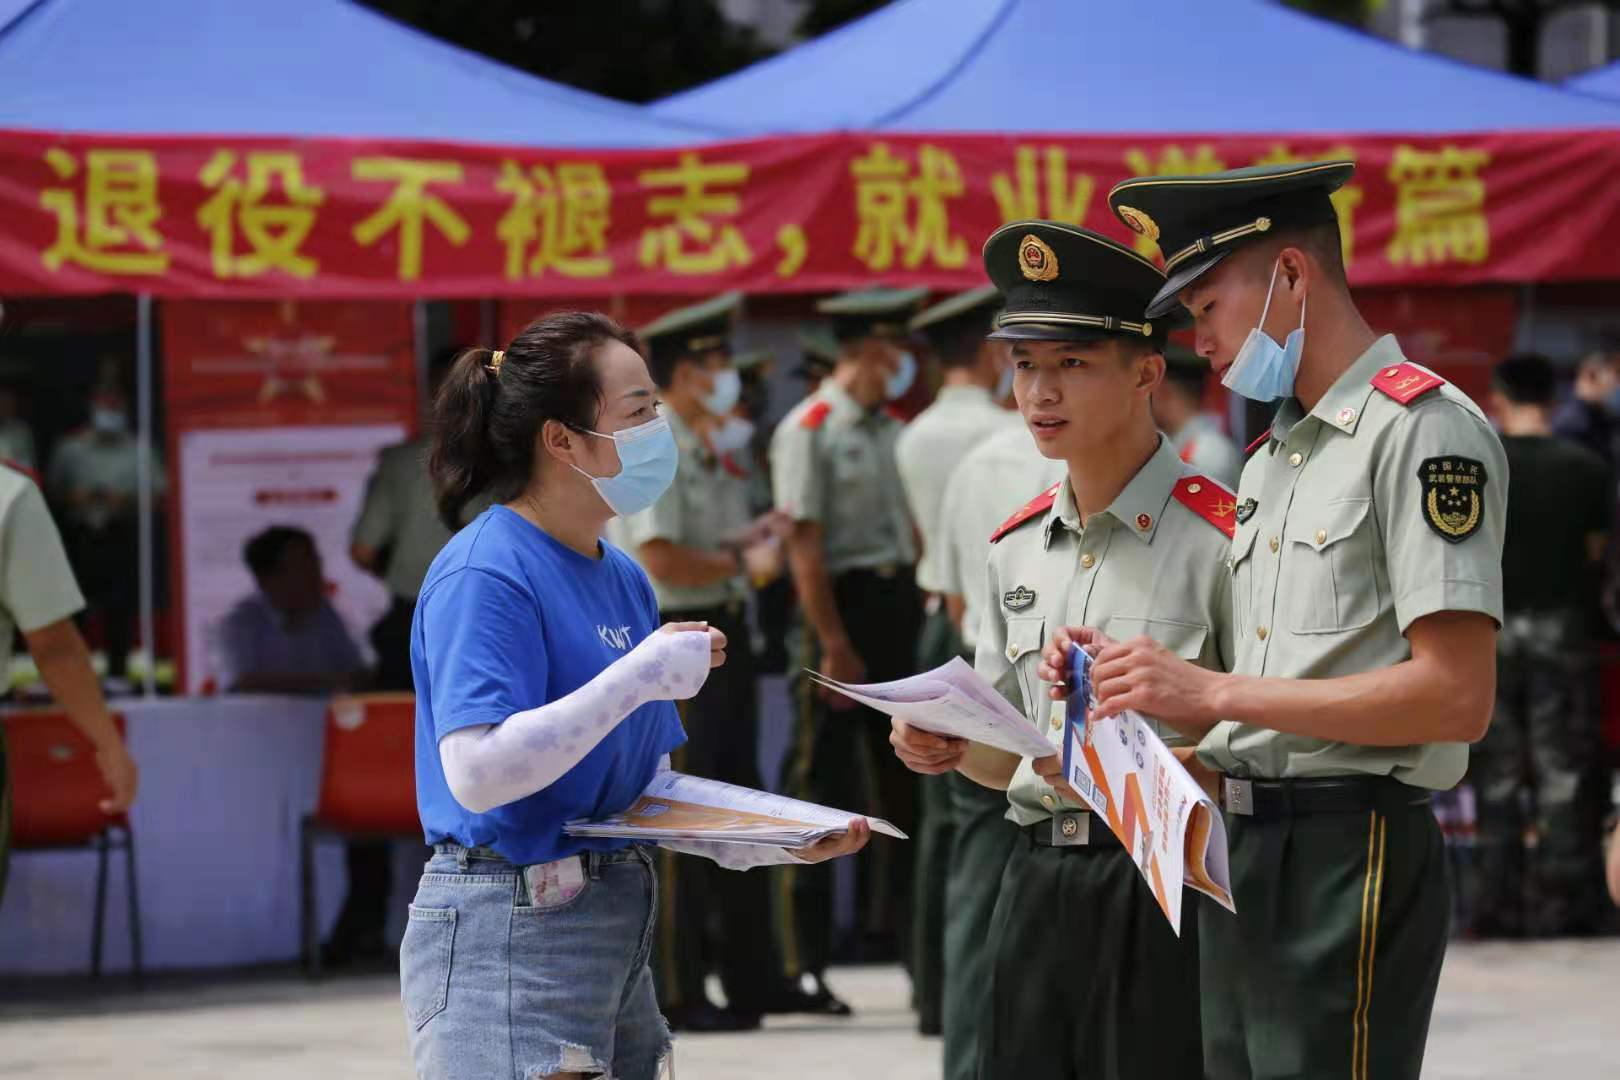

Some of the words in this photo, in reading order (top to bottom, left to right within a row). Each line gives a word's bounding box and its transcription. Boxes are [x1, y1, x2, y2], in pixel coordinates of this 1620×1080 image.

[41, 144, 1489, 280] 退役不褪志，就业篇
[1428, 461, 1478, 475] 中国人民
[597, 625, 633, 650] KWT
